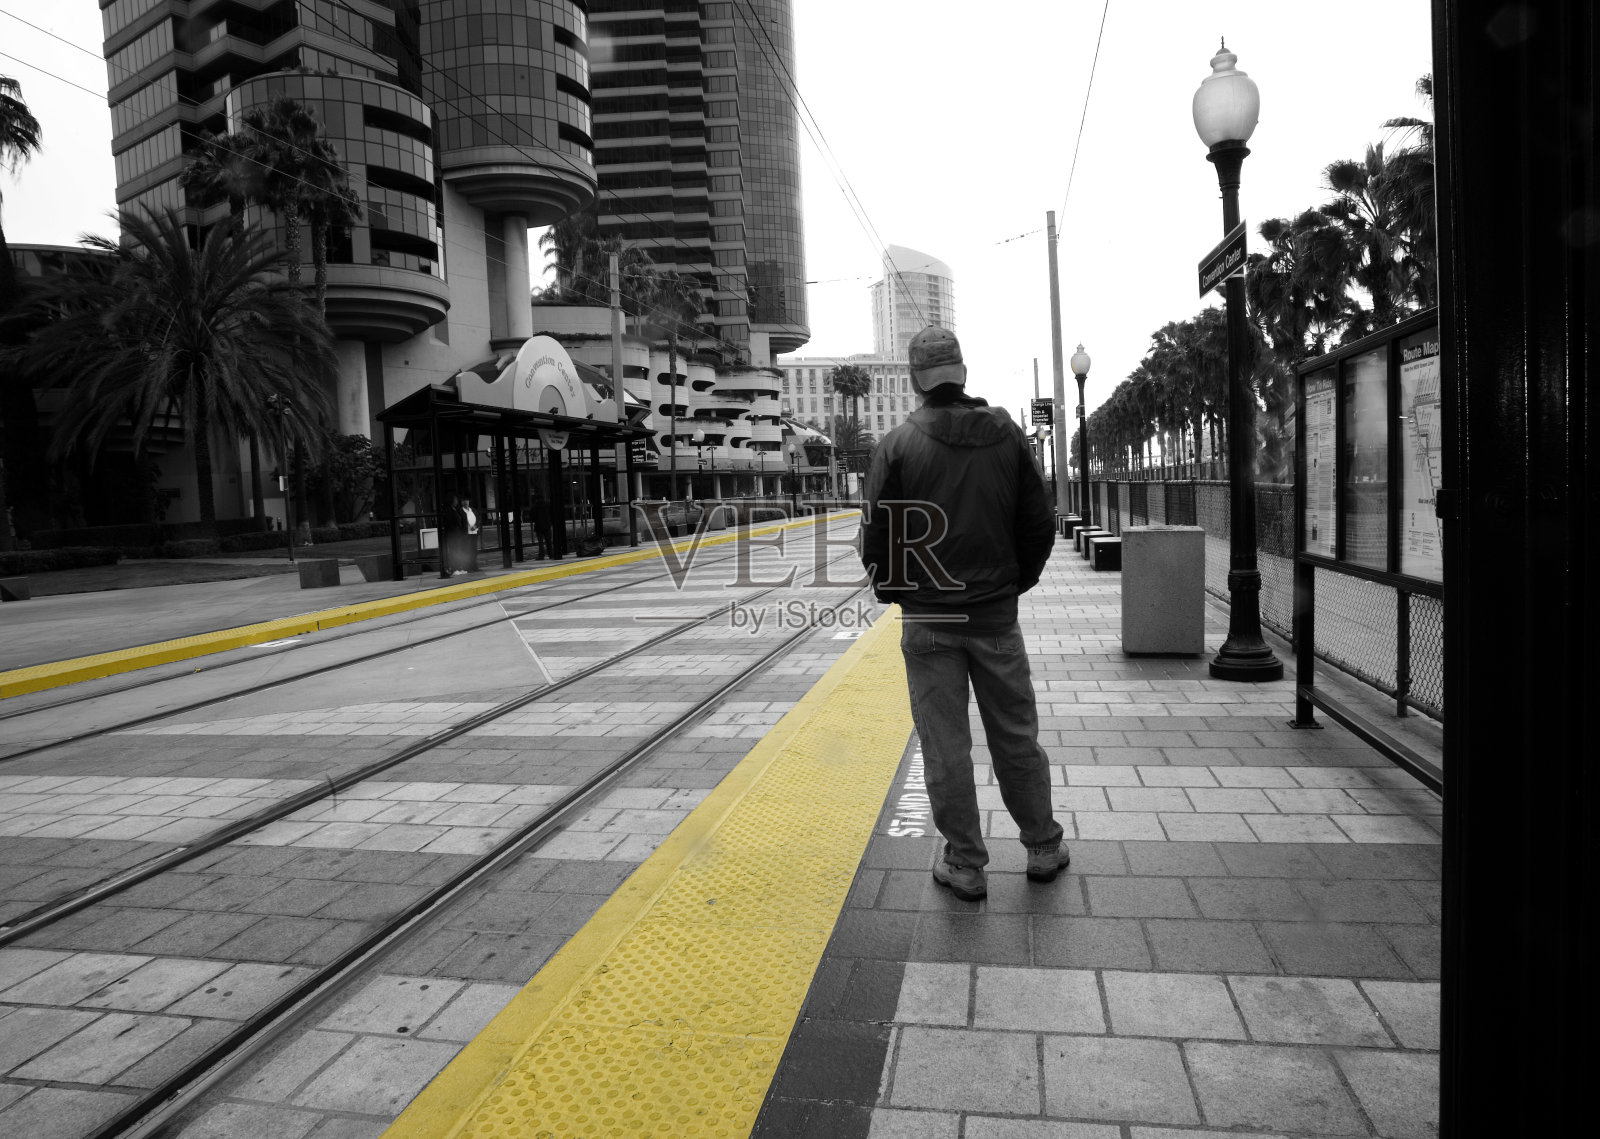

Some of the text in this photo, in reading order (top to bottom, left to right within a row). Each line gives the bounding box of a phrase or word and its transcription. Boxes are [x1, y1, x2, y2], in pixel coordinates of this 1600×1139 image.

[1203, 248, 1241, 288] Convention Center
[1403, 341, 1439, 361] Route Map
[525, 354, 576, 398] Convention Center
[887, 793, 931, 837] STAND
